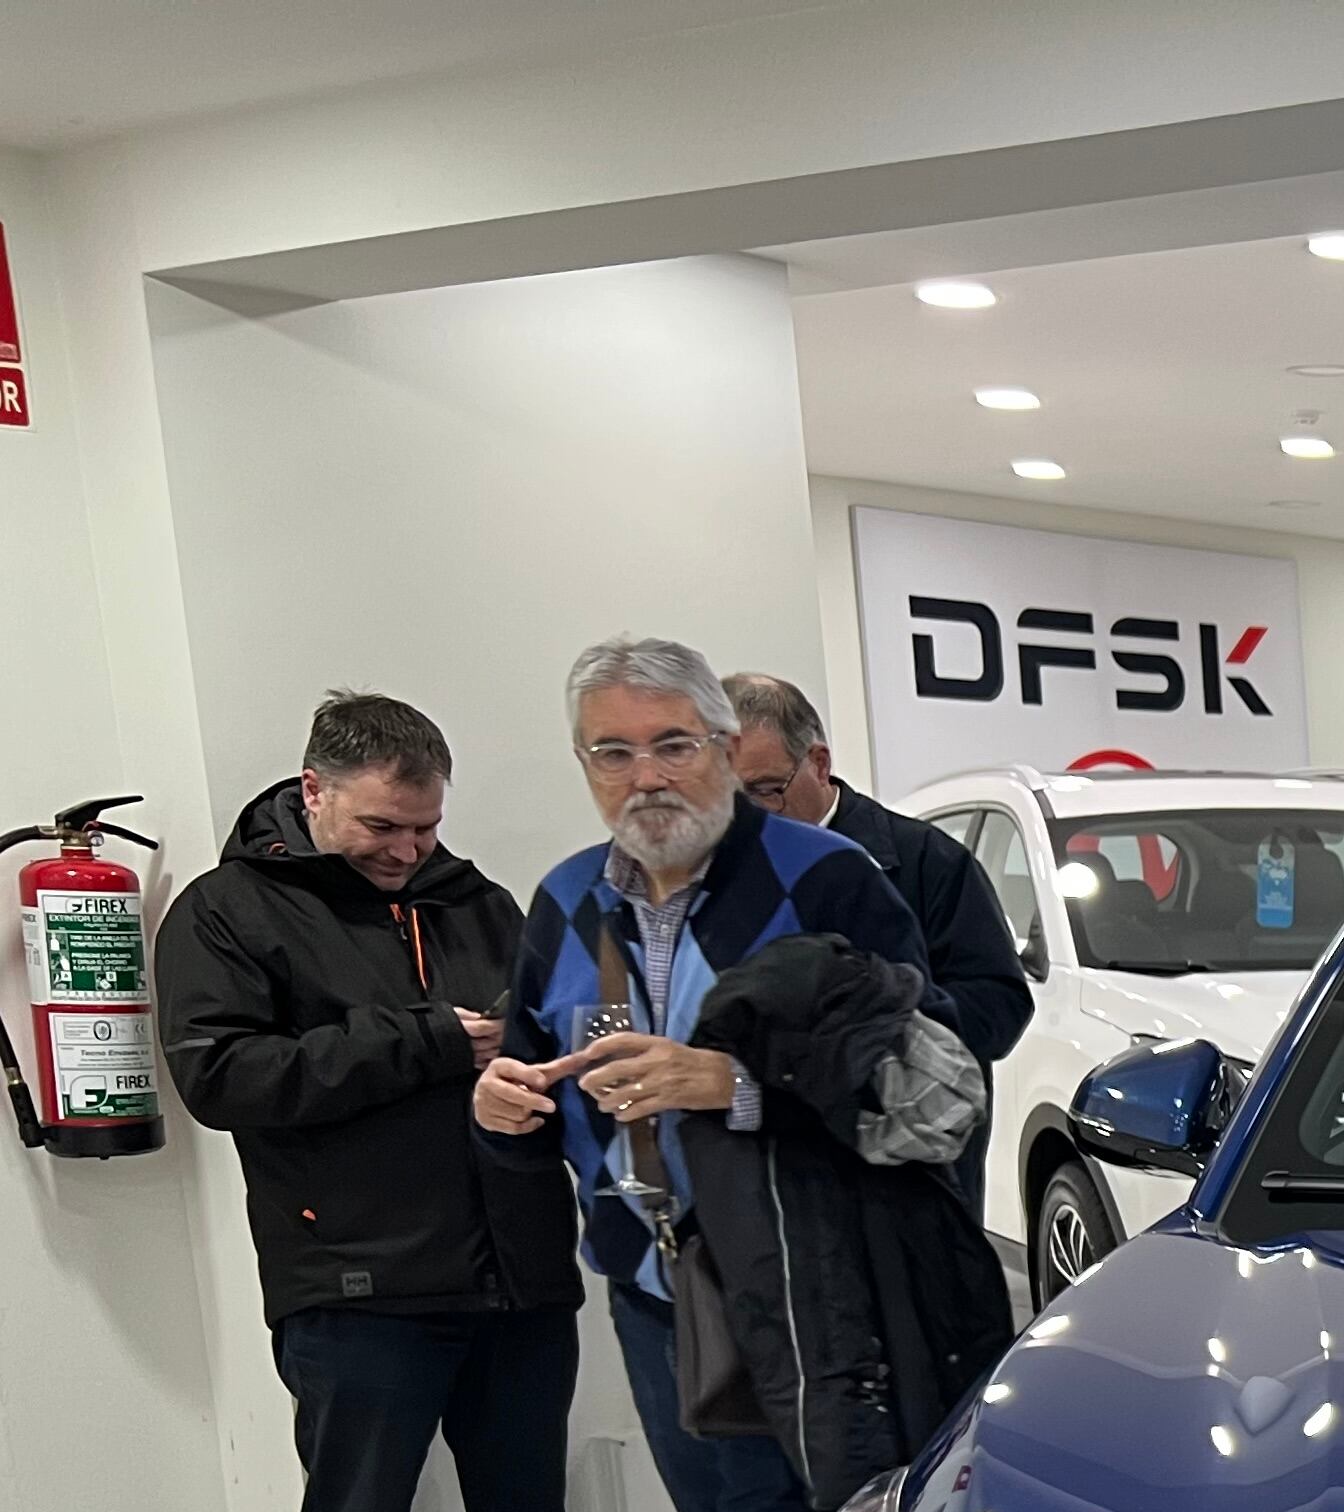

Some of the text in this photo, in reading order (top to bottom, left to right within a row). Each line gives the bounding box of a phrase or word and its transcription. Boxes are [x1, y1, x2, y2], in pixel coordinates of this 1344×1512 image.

[908, 594, 1274, 718] DFSK
[84, 898, 128, 914] FIREX
[116, 1074, 151, 1089] FIREX
